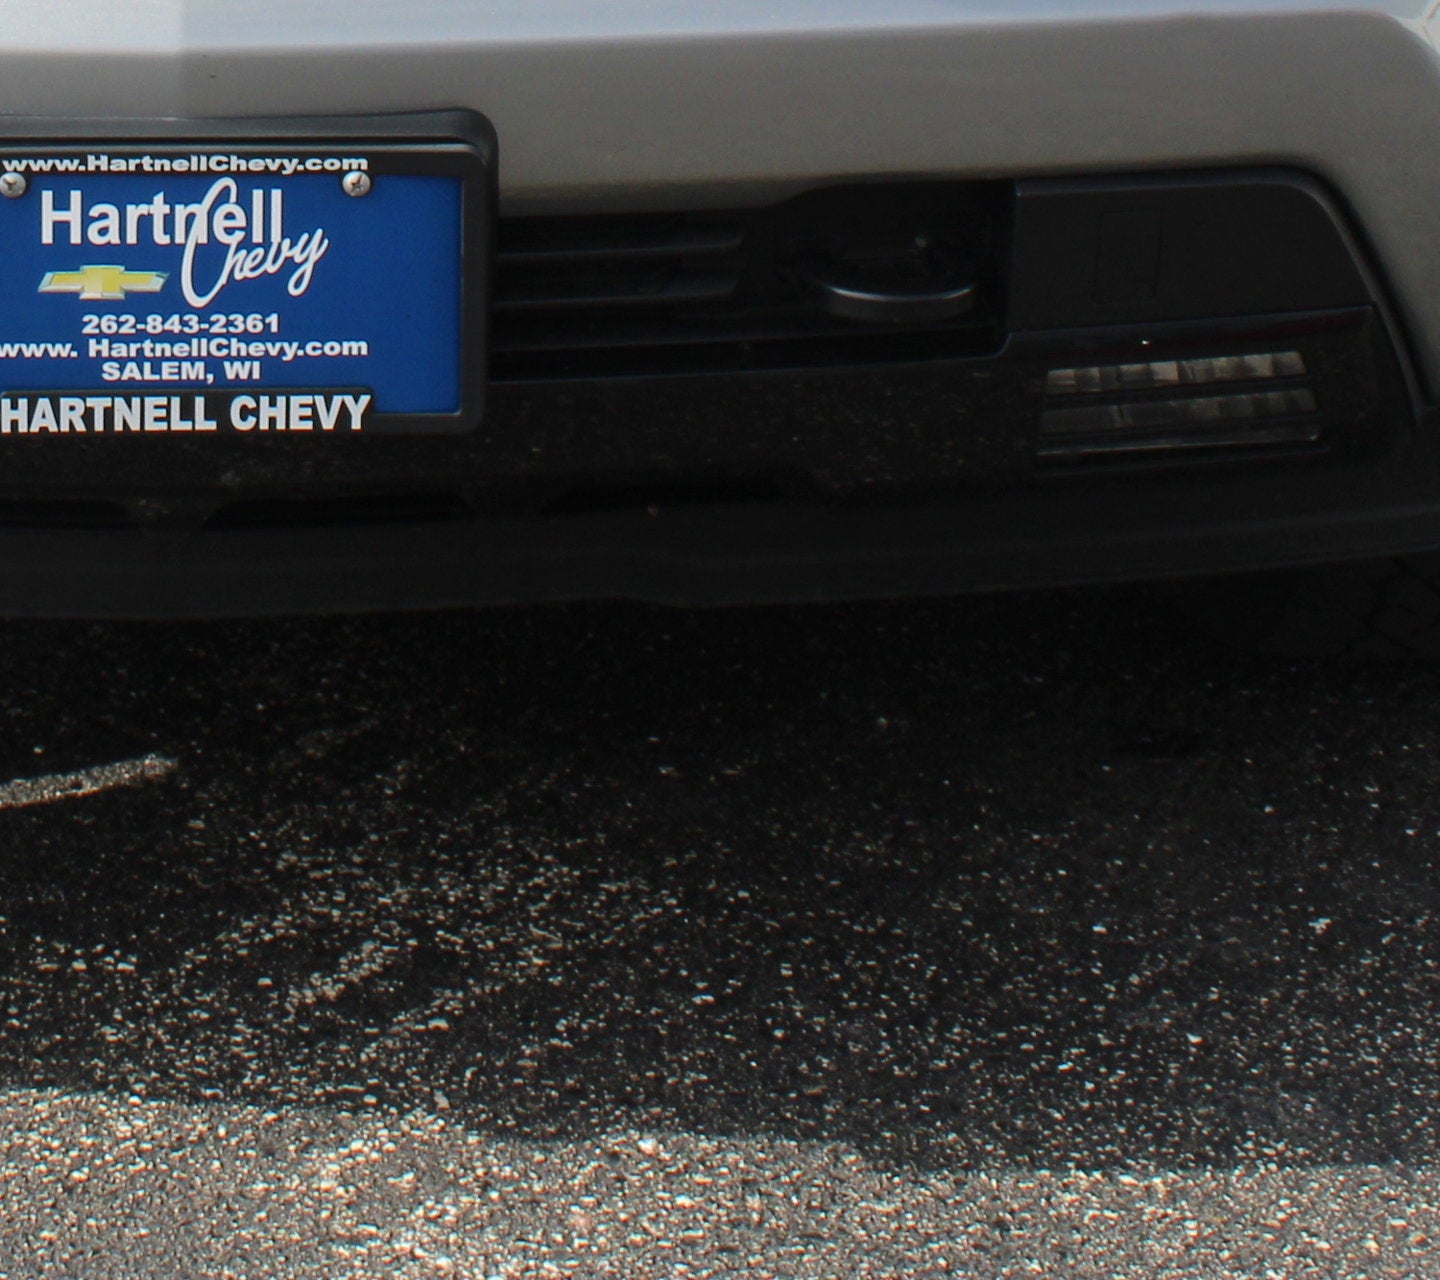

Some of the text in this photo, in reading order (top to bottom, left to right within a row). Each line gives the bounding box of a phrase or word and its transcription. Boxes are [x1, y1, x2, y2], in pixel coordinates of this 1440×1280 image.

[1, 153, 369, 175] www.HartnellChevy.com
[40, 188, 282, 246] Hartnell
[180, 176, 329, 308] Chevy
[80, 313, 279, 335] 262-843-2361
[100, 360, 262, 385] SALEM, WI
[0, 393, 372, 434] HARTNELL CHEVY
